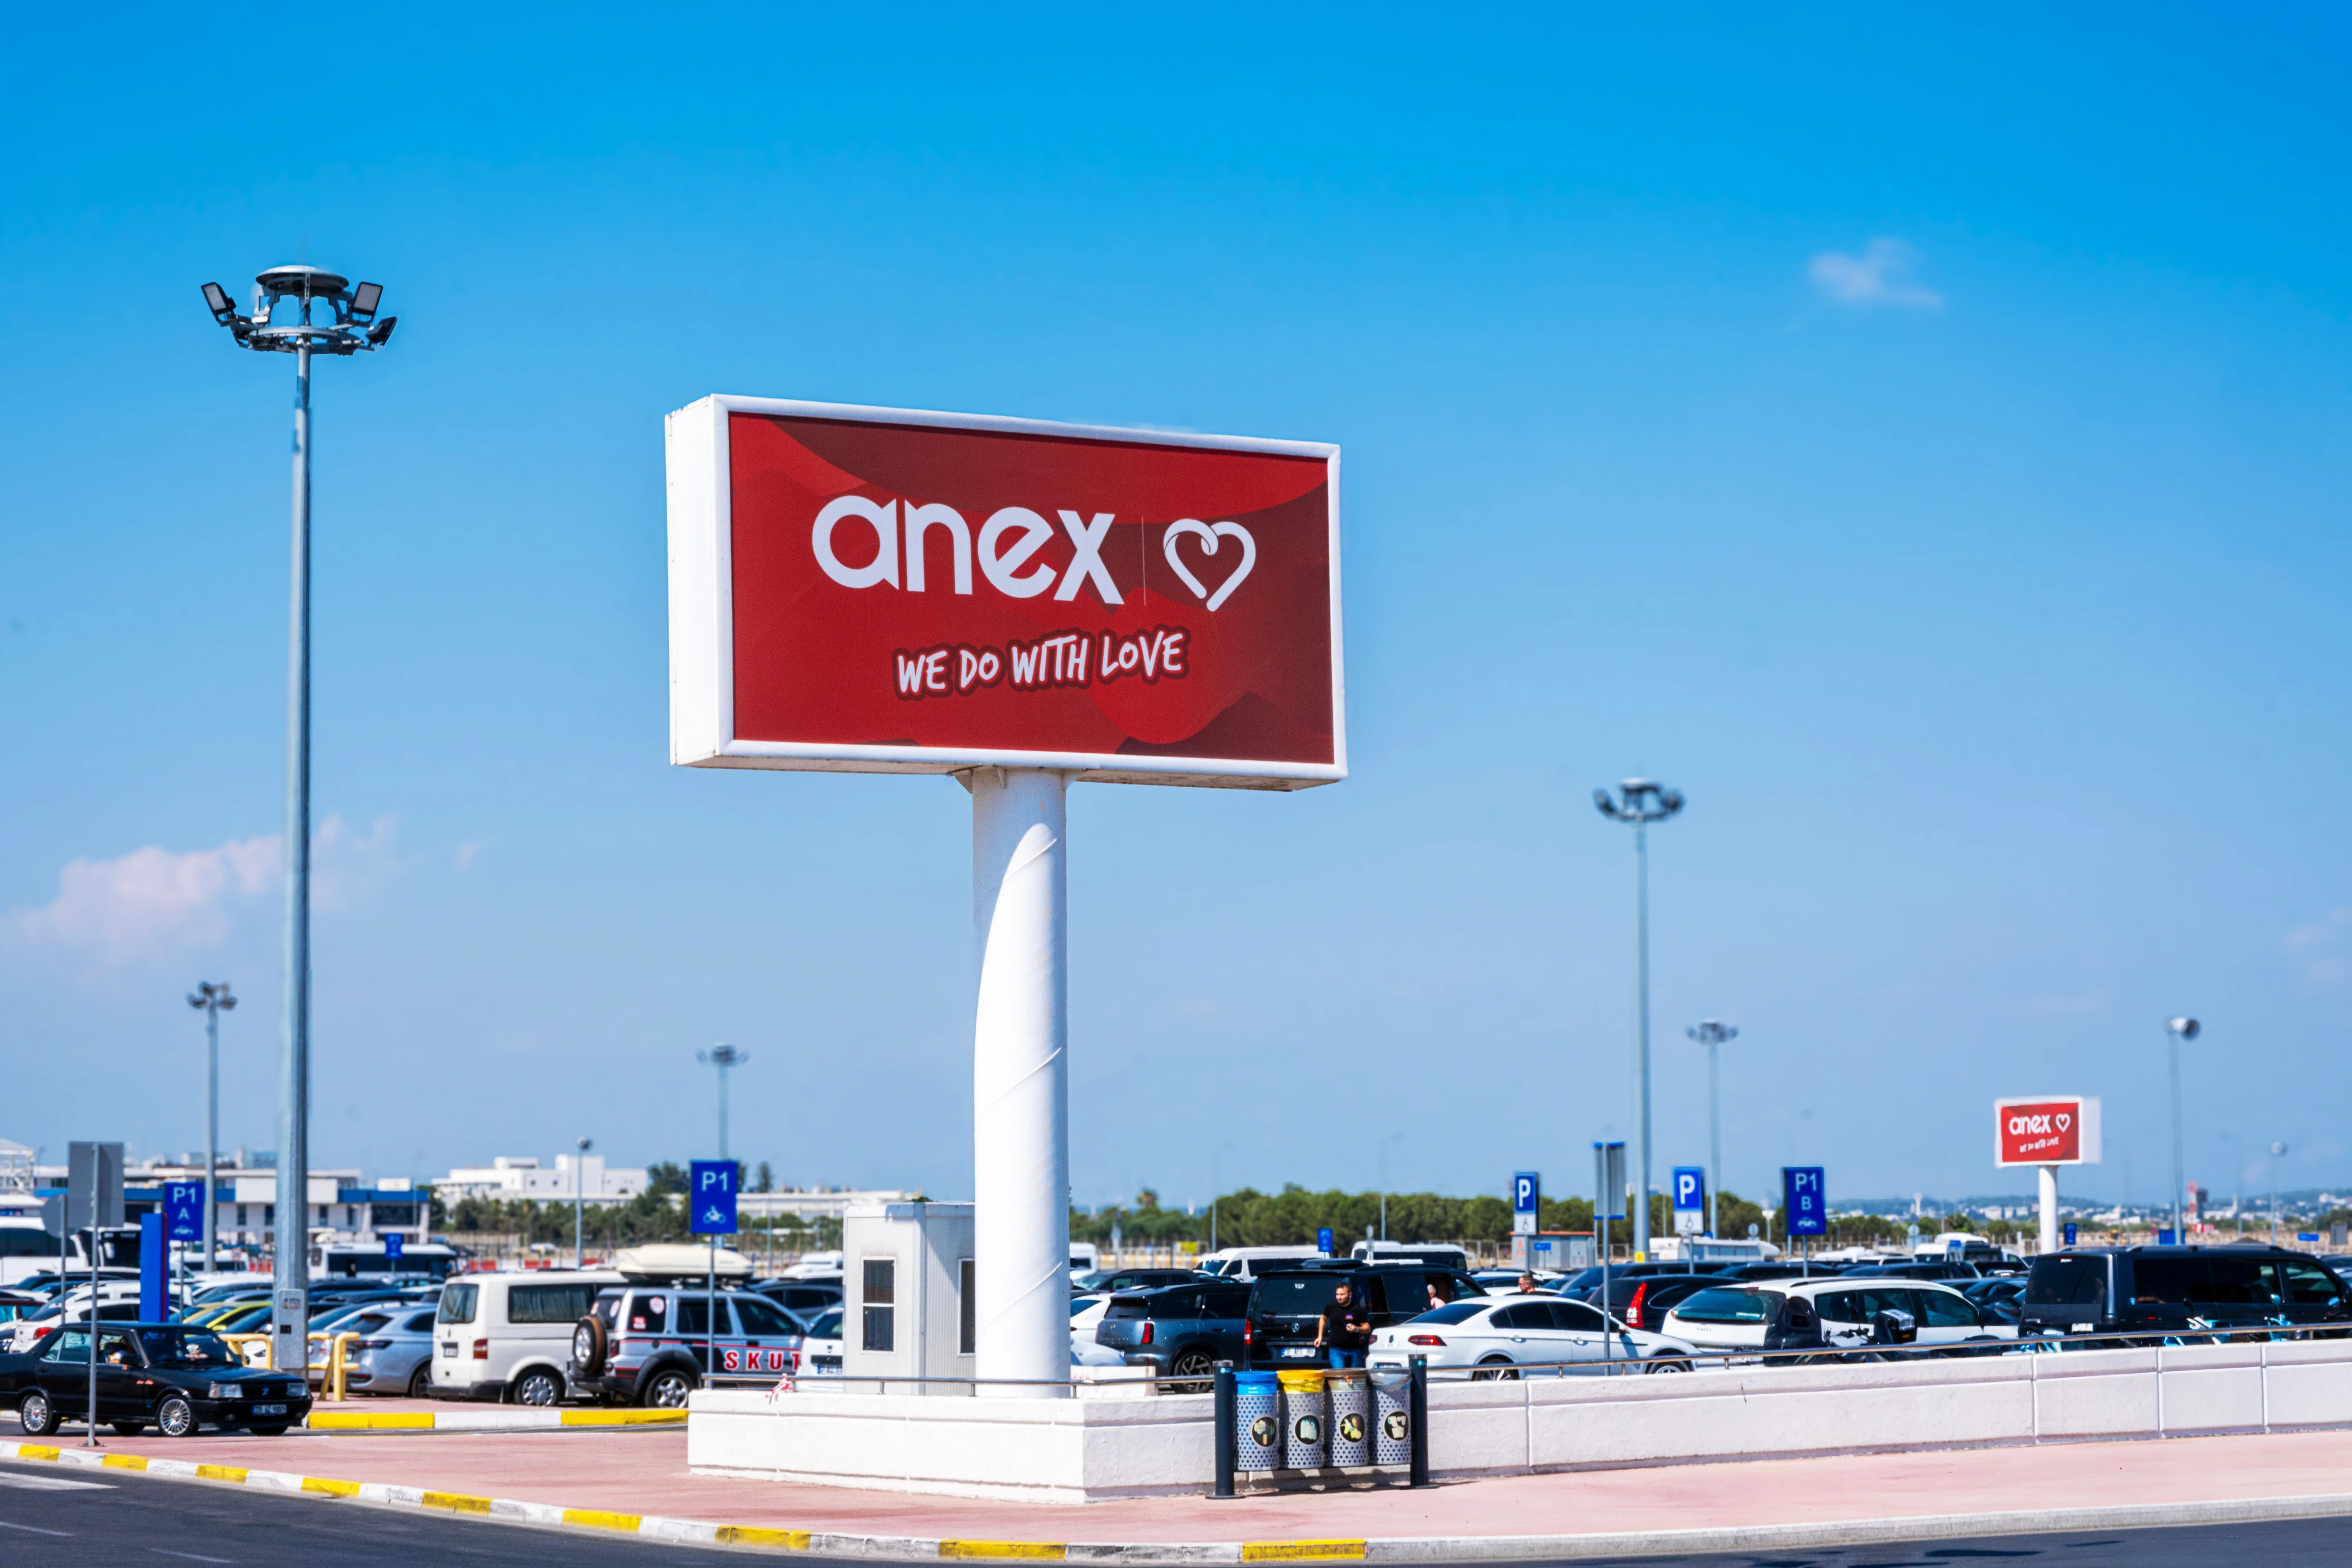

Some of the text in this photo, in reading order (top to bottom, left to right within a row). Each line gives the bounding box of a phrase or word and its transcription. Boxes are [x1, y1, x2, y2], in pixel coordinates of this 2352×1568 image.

[812, 495, 1124, 605] anex
[898, 630, 1183, 693] WE DO WITH LOVE
[2009, 1114, 2052, 1135] anex
[702, 1171, 728, 1192] P1
[1679, 1175, 1696, 1205] P
[1795, 1172, 1817, 1192] P1
[173, 1186, 196, 1204] P1
[1518, 1179, 1531, 1207] P
[1801, 1195, 1812, 1211] B
[177, 1206, 191, 1221] A
